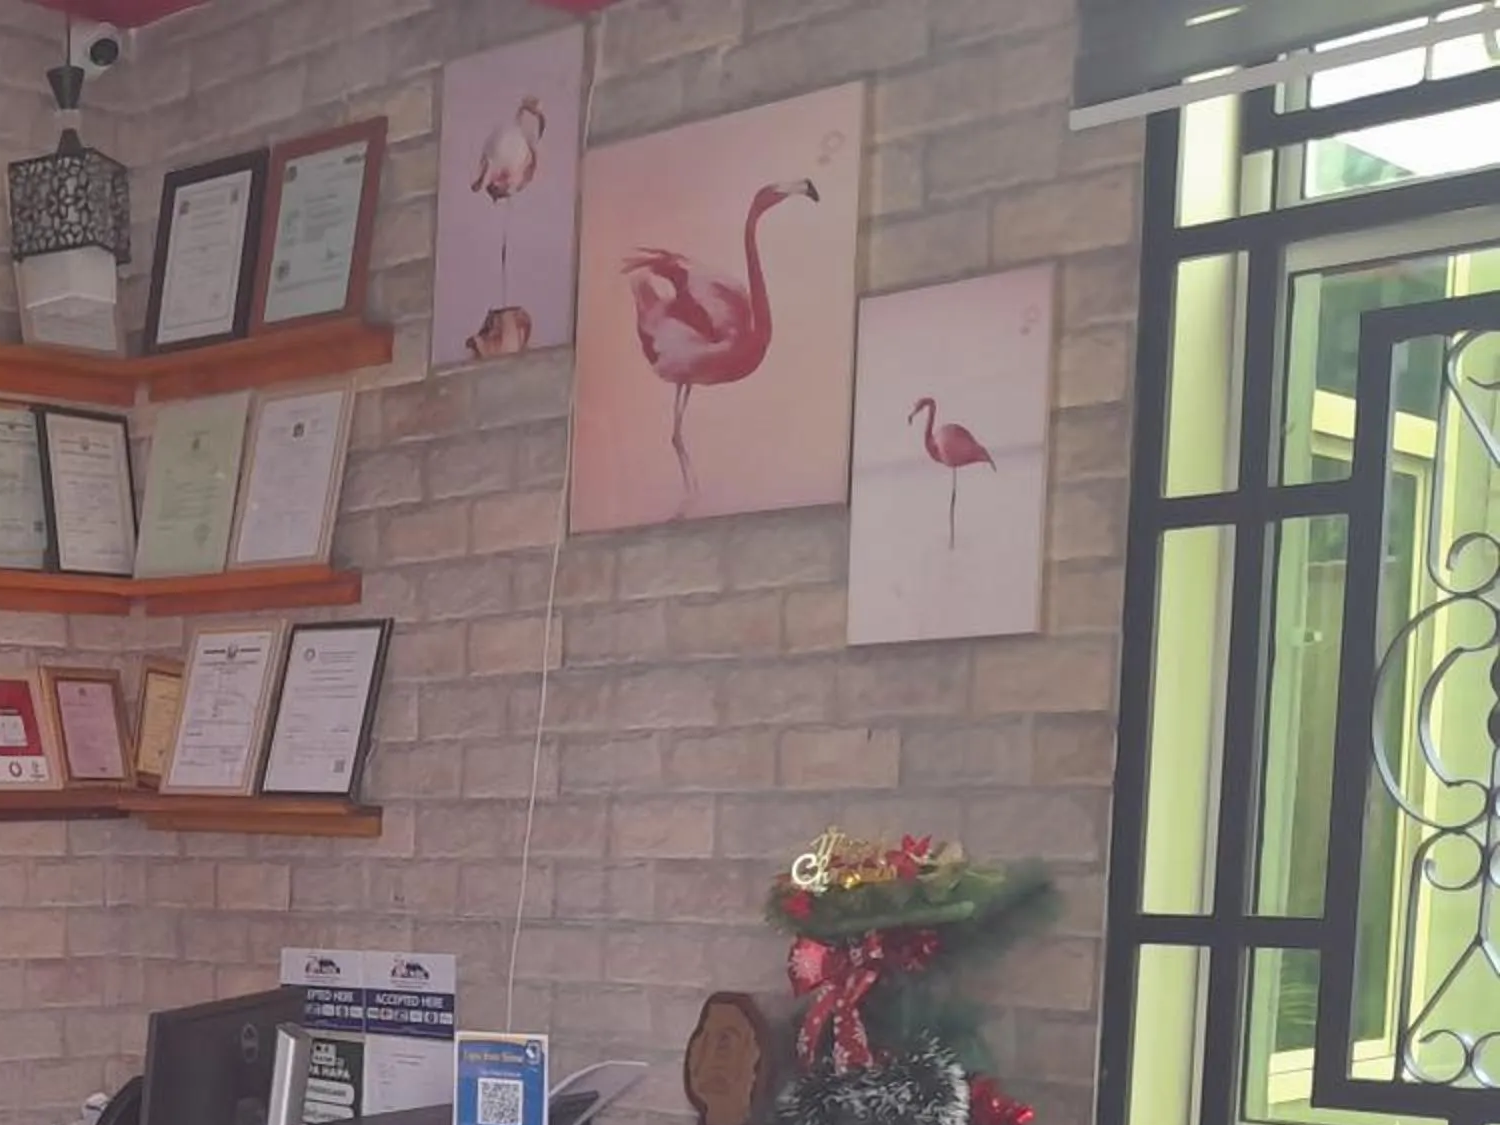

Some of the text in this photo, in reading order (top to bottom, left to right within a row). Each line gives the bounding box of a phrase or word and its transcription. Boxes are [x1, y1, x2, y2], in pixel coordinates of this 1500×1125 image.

[333, 990, 354, 1002] HERE
[375, 993, 444, 1009] ACCEPTED HERE
